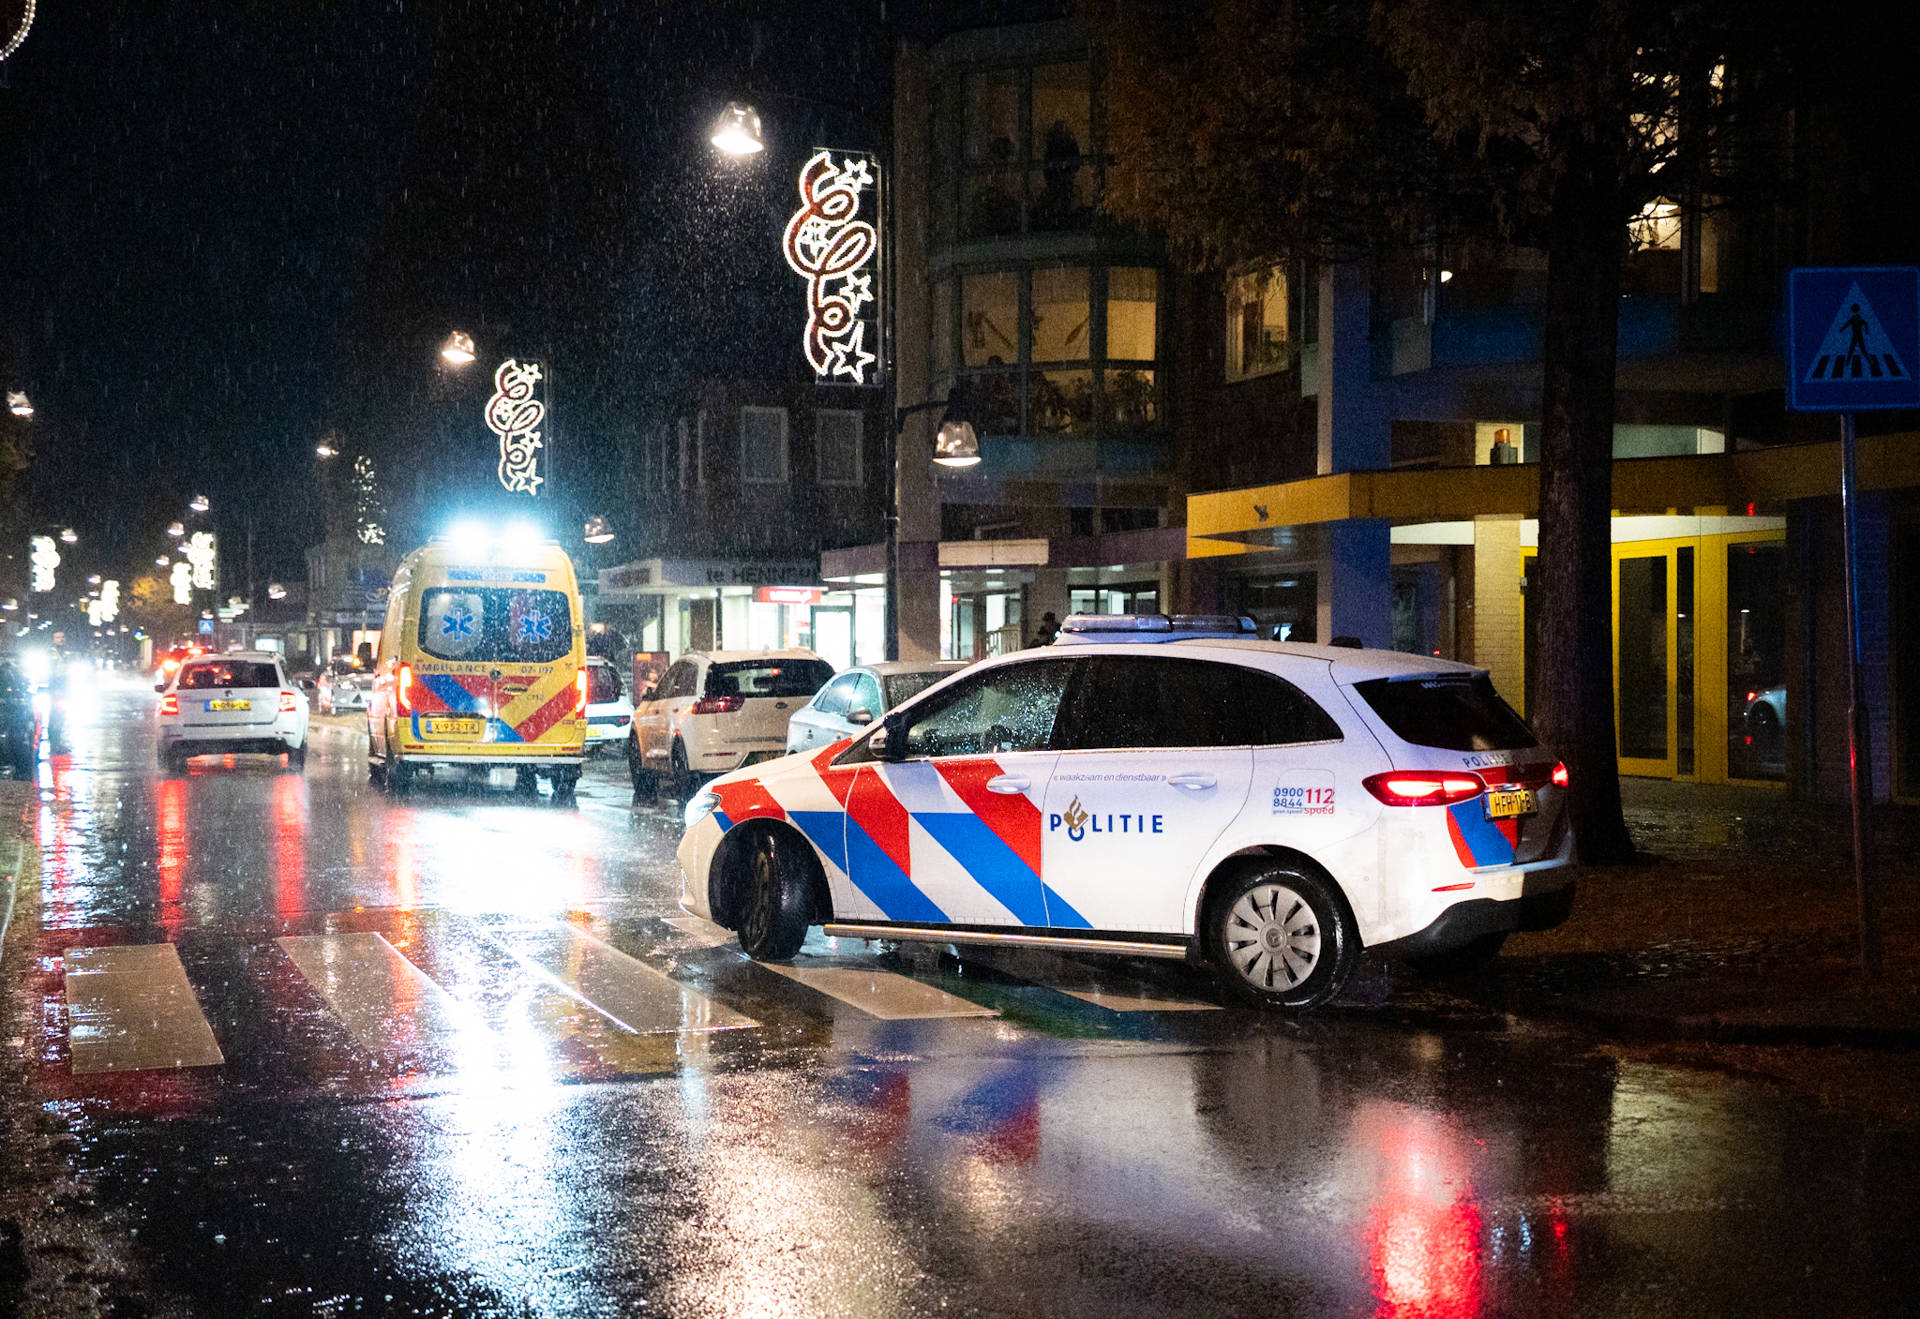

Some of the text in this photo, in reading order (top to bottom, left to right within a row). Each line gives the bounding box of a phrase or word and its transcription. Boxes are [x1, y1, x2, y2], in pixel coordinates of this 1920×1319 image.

[414, 663, 488, 673] AMBULANCE
[1115, 773, 1160, 781] dienstbaar
[1273, 787, 1304, 797] 0900
[1306, 788, 1334, 804] 112
[1273, 797, 1303, 807] 8844
[1304, 806, 1334, 815] spoed
[1050, 813, 1163, 841] POLITIE
